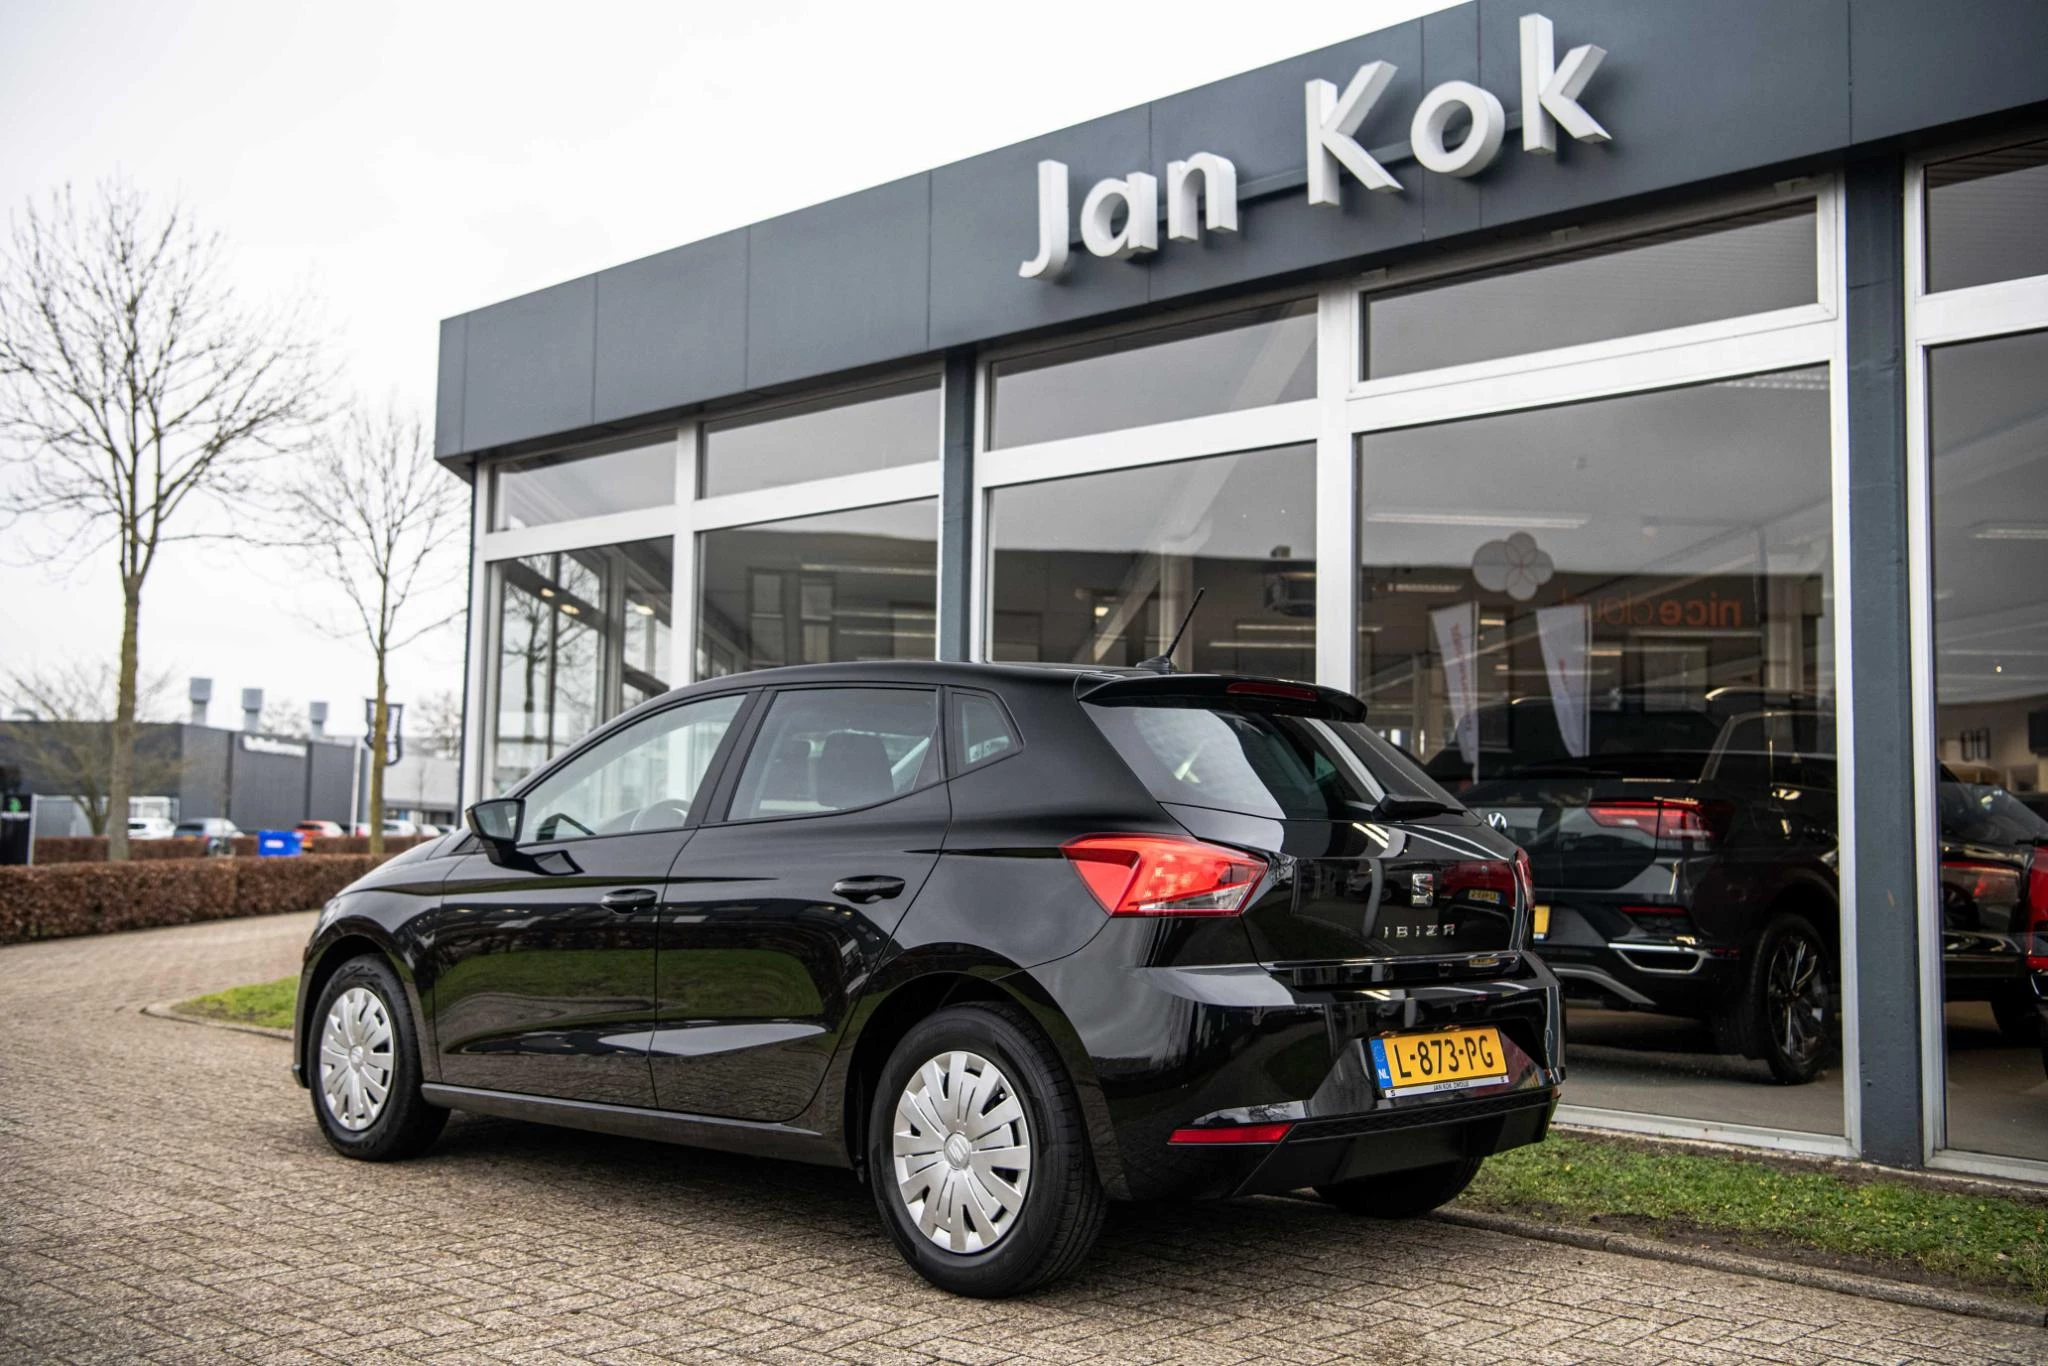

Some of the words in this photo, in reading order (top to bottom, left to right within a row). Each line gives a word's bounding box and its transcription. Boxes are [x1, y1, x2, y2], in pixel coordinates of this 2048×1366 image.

[1019, 151, 1238, 279] Jan
[1304, 13, 1612, 206] Kok
[1383, 923, 1455, 939] IBIZA
[1378, 1069, 1390, 1080] NL
[1394, 1034, 1495, 1078] L-873-PG
